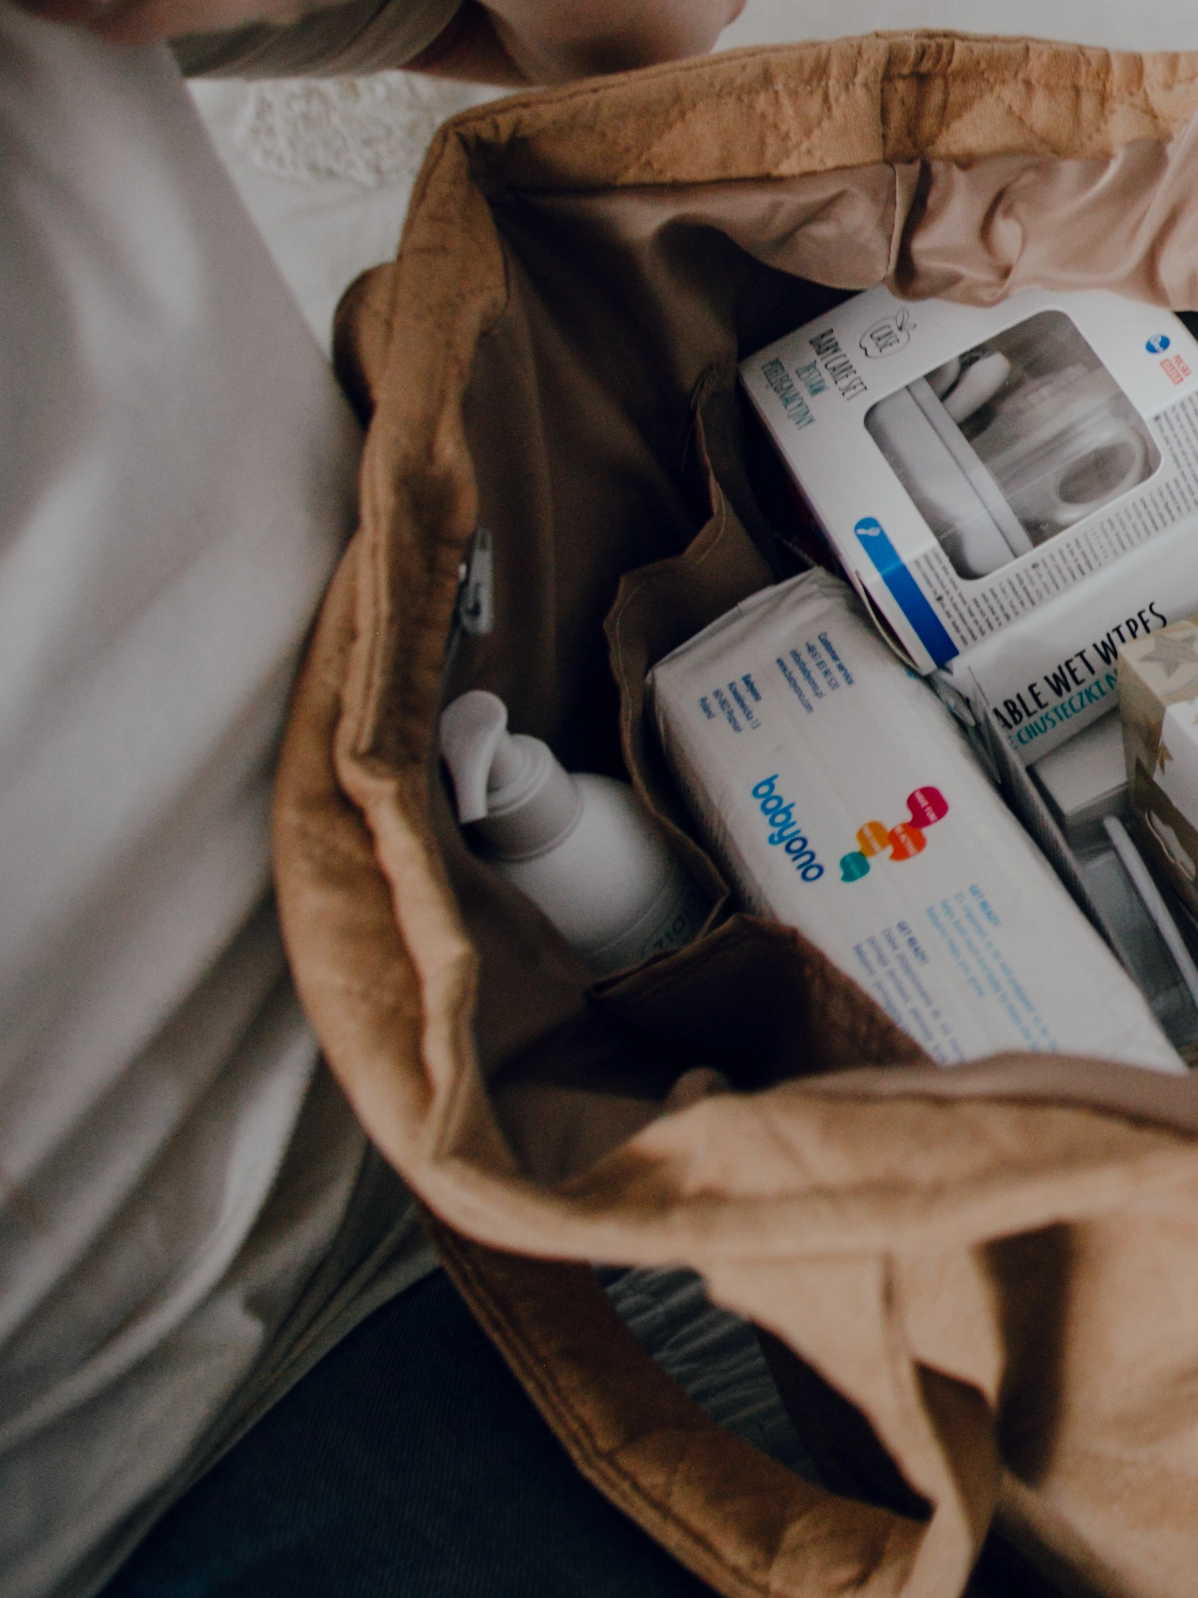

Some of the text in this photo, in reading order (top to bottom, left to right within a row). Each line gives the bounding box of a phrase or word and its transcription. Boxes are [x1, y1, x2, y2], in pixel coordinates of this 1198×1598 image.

[808, 327, 868, 402] BABY CARE SET
[1042, 647, 1097, 699] WET
[1014, 677, 1108, 744] CHUSTECZKI
[749, 772, 827, 884] babyono
[966, 881, 986, 902] GET
[894, 918, 913, 939] GET
